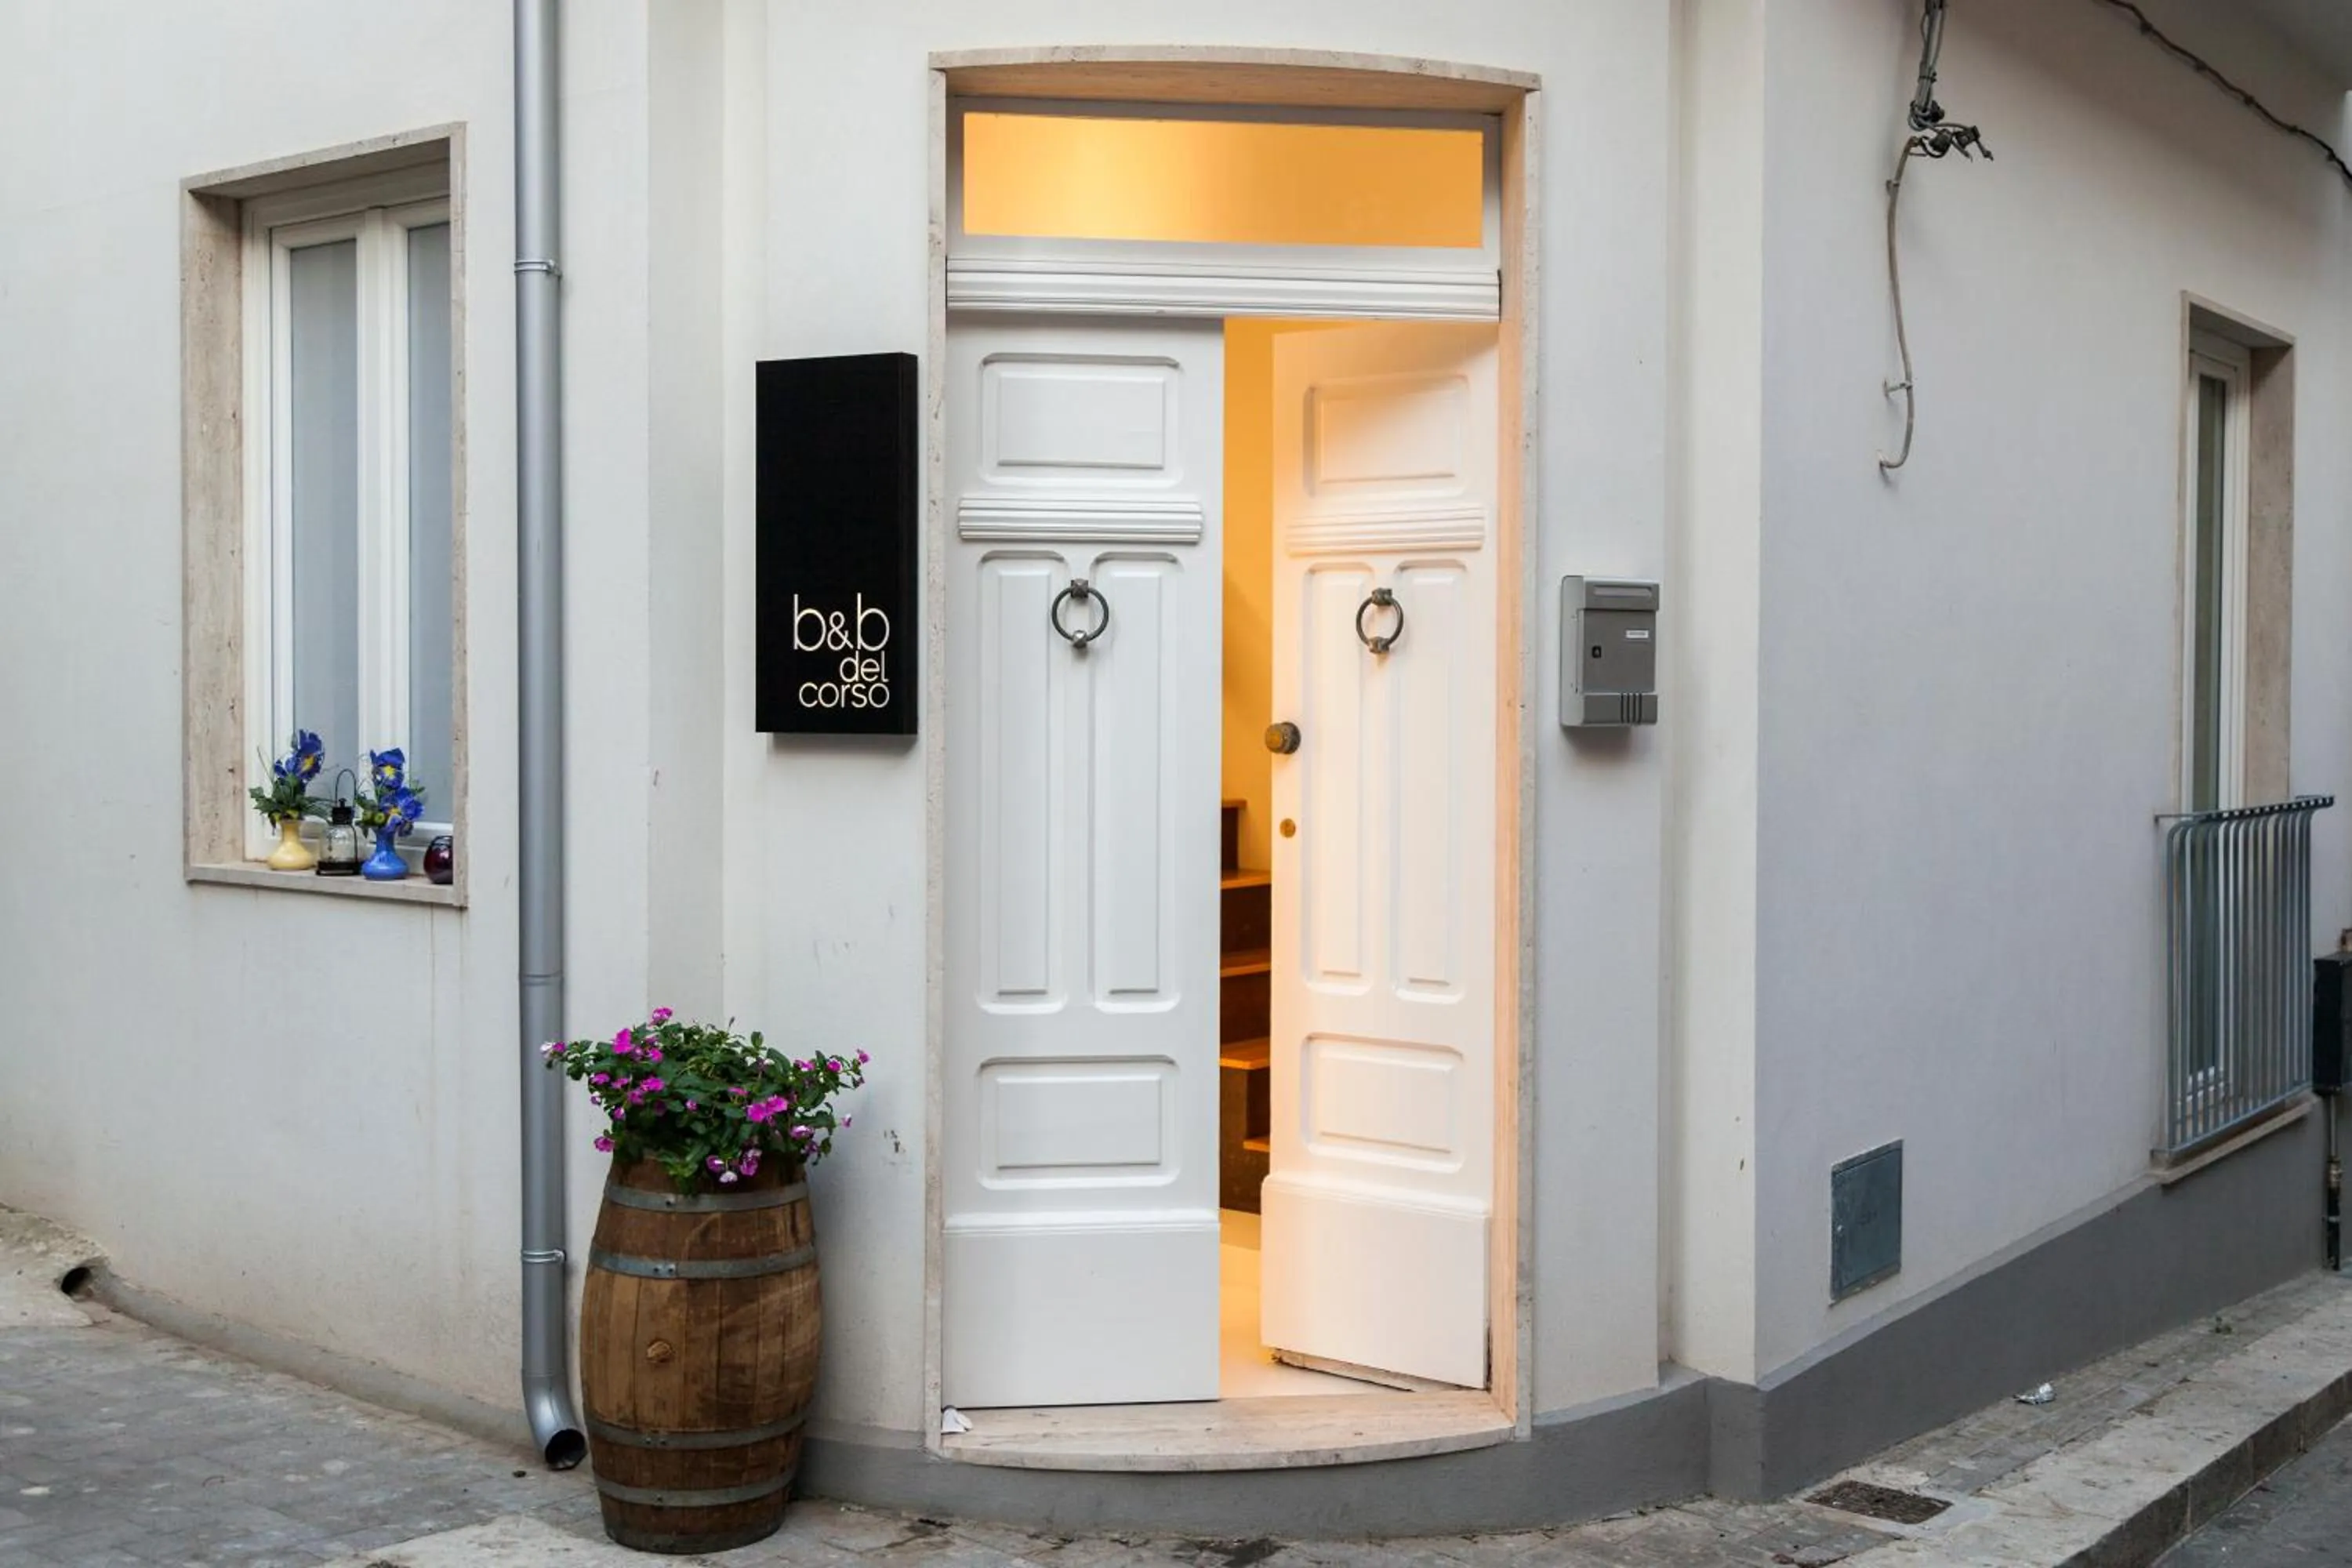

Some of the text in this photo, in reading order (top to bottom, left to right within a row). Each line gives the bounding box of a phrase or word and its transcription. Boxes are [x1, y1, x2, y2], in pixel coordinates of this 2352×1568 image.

[793, 592, 891, 652] b&b
[839, 650, 890, 683] del
[798, 682, 891, 708] corso
